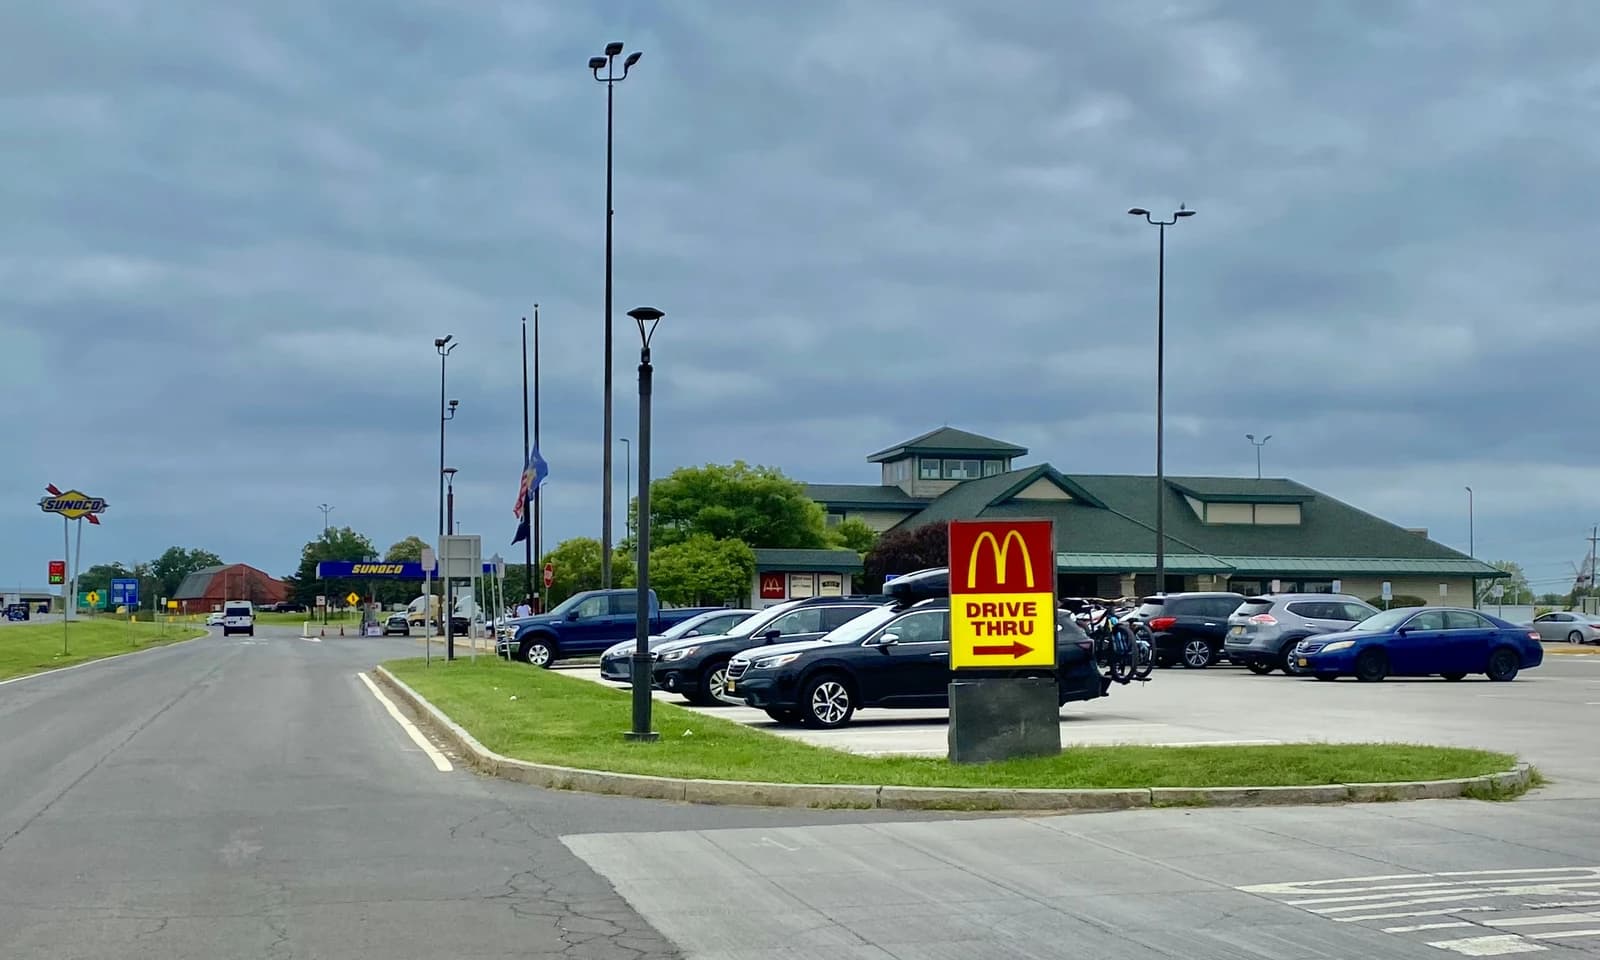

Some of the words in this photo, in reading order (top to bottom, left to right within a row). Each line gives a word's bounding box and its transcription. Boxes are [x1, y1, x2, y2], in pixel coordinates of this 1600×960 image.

[45, 500, 101, 510] SUNOCO
[351, 564, 404, 574] SUNOCO
[966, 602, 1037, 618] DRIVE
[971, 620, 1034, 636] THRU
